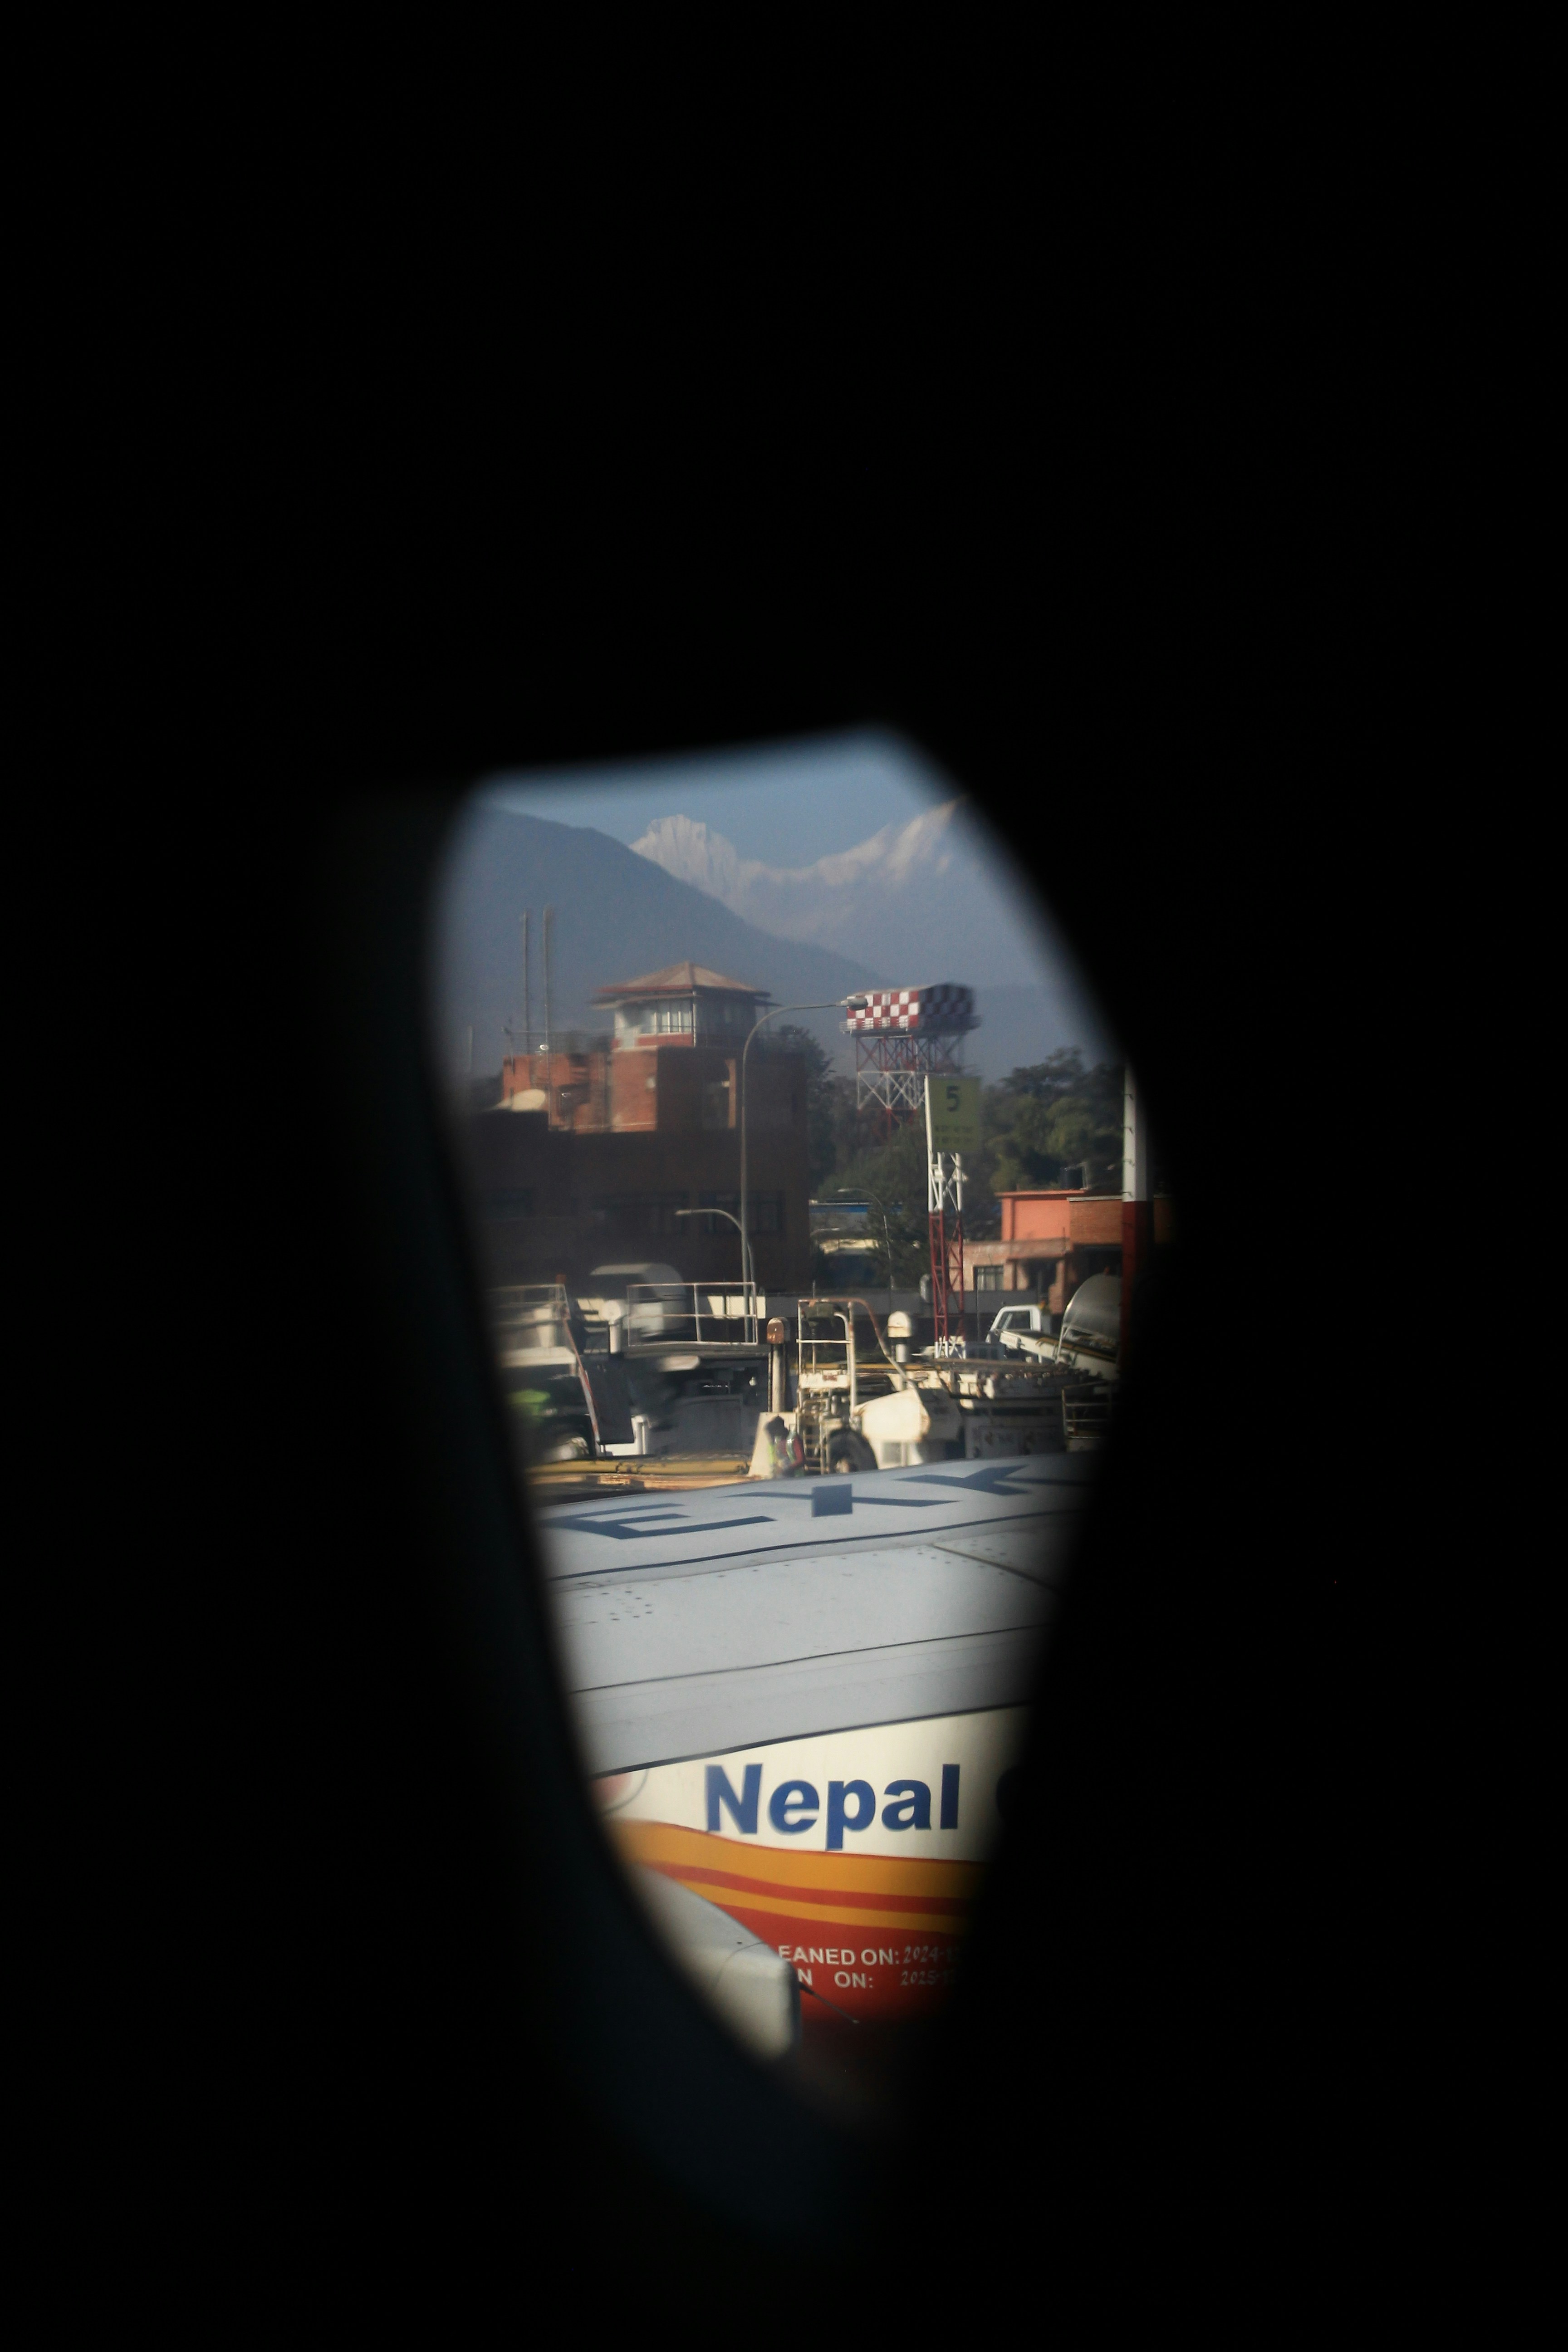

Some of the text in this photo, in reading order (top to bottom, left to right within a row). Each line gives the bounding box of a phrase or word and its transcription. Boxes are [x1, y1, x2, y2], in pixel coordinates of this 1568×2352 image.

[946, 1085, 960, 1112] 5
[705, 1763, 960, 1851] Nepal
[861, 1948, 900, 1966] ON:
[834, 1971, 874, 1989] ON:
